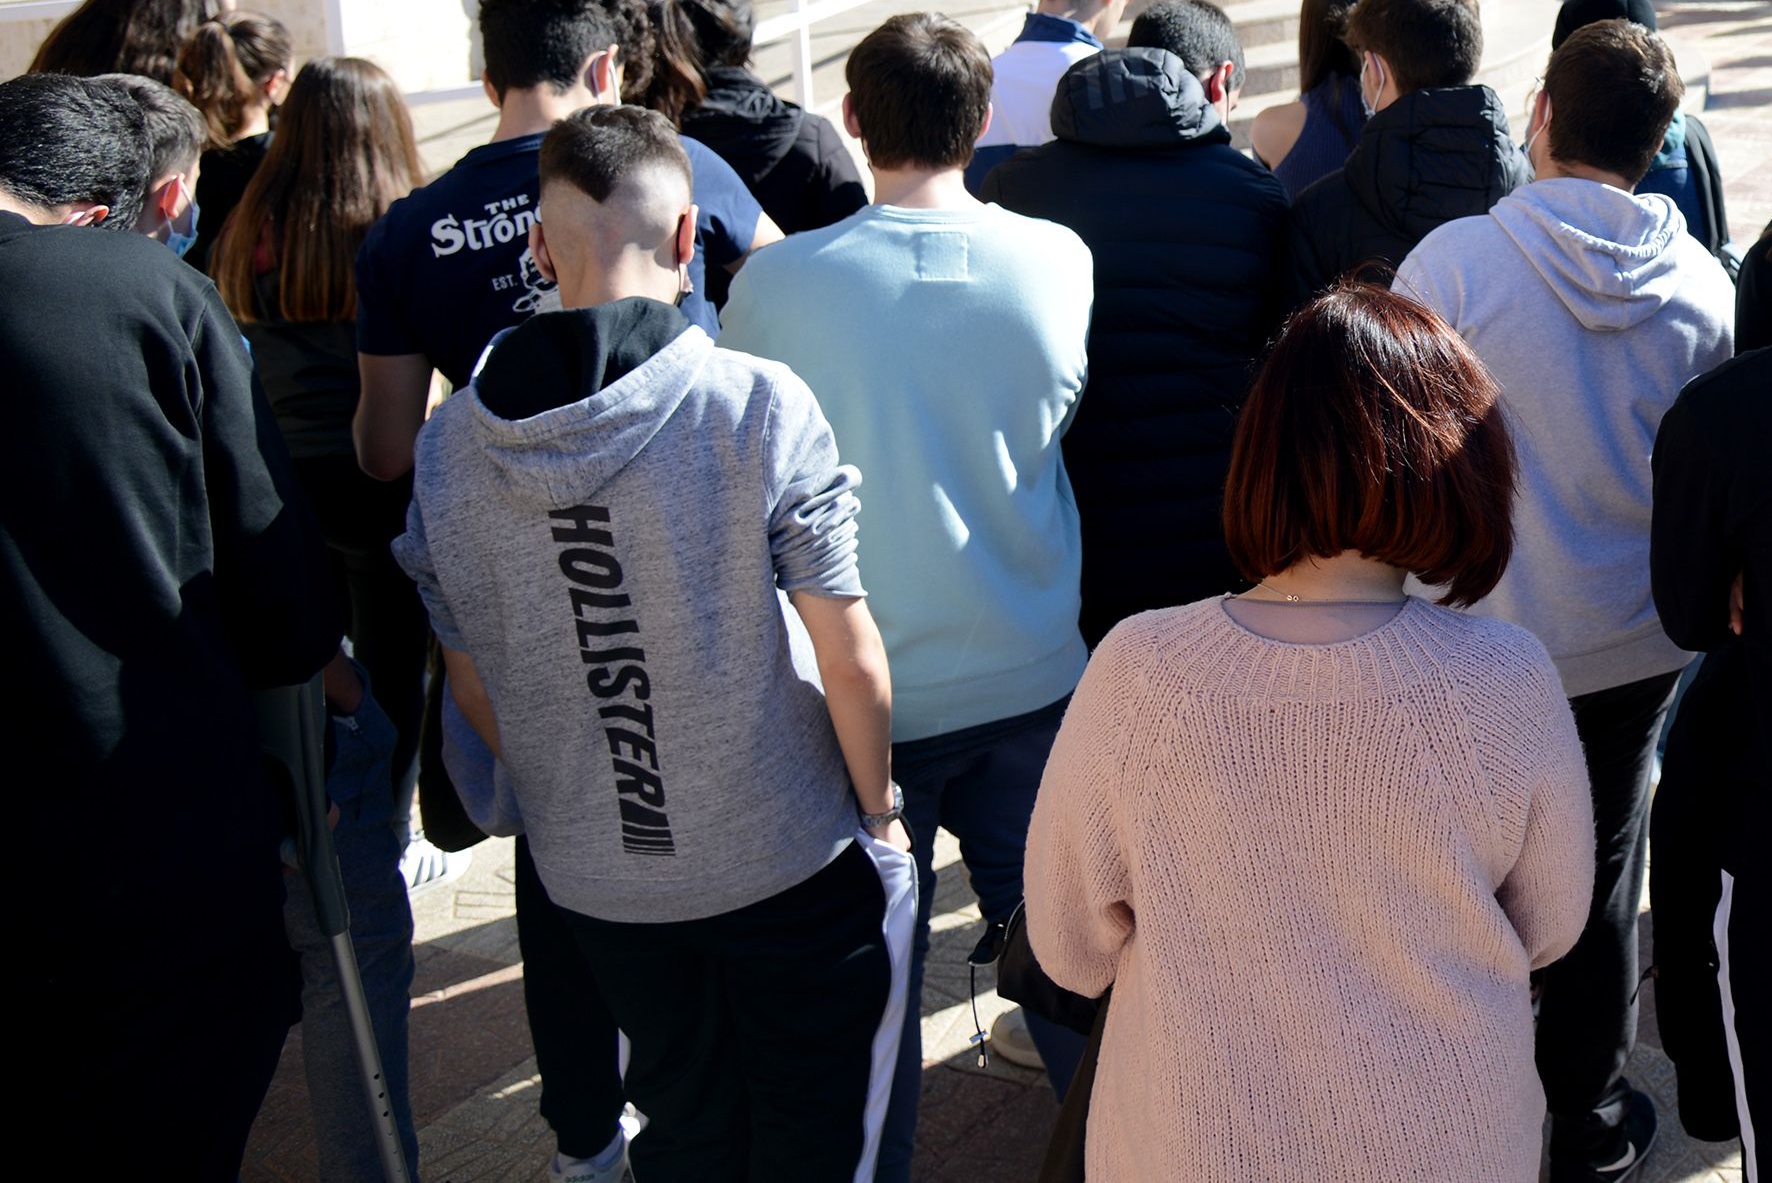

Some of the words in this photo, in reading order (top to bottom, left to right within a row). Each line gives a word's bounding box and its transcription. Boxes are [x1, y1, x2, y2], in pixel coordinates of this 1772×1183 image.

[484, 194, 530, 216] THE
[492, 274, 518, 291] EST.
[548, 504, 666, 808] HOLLISTER
